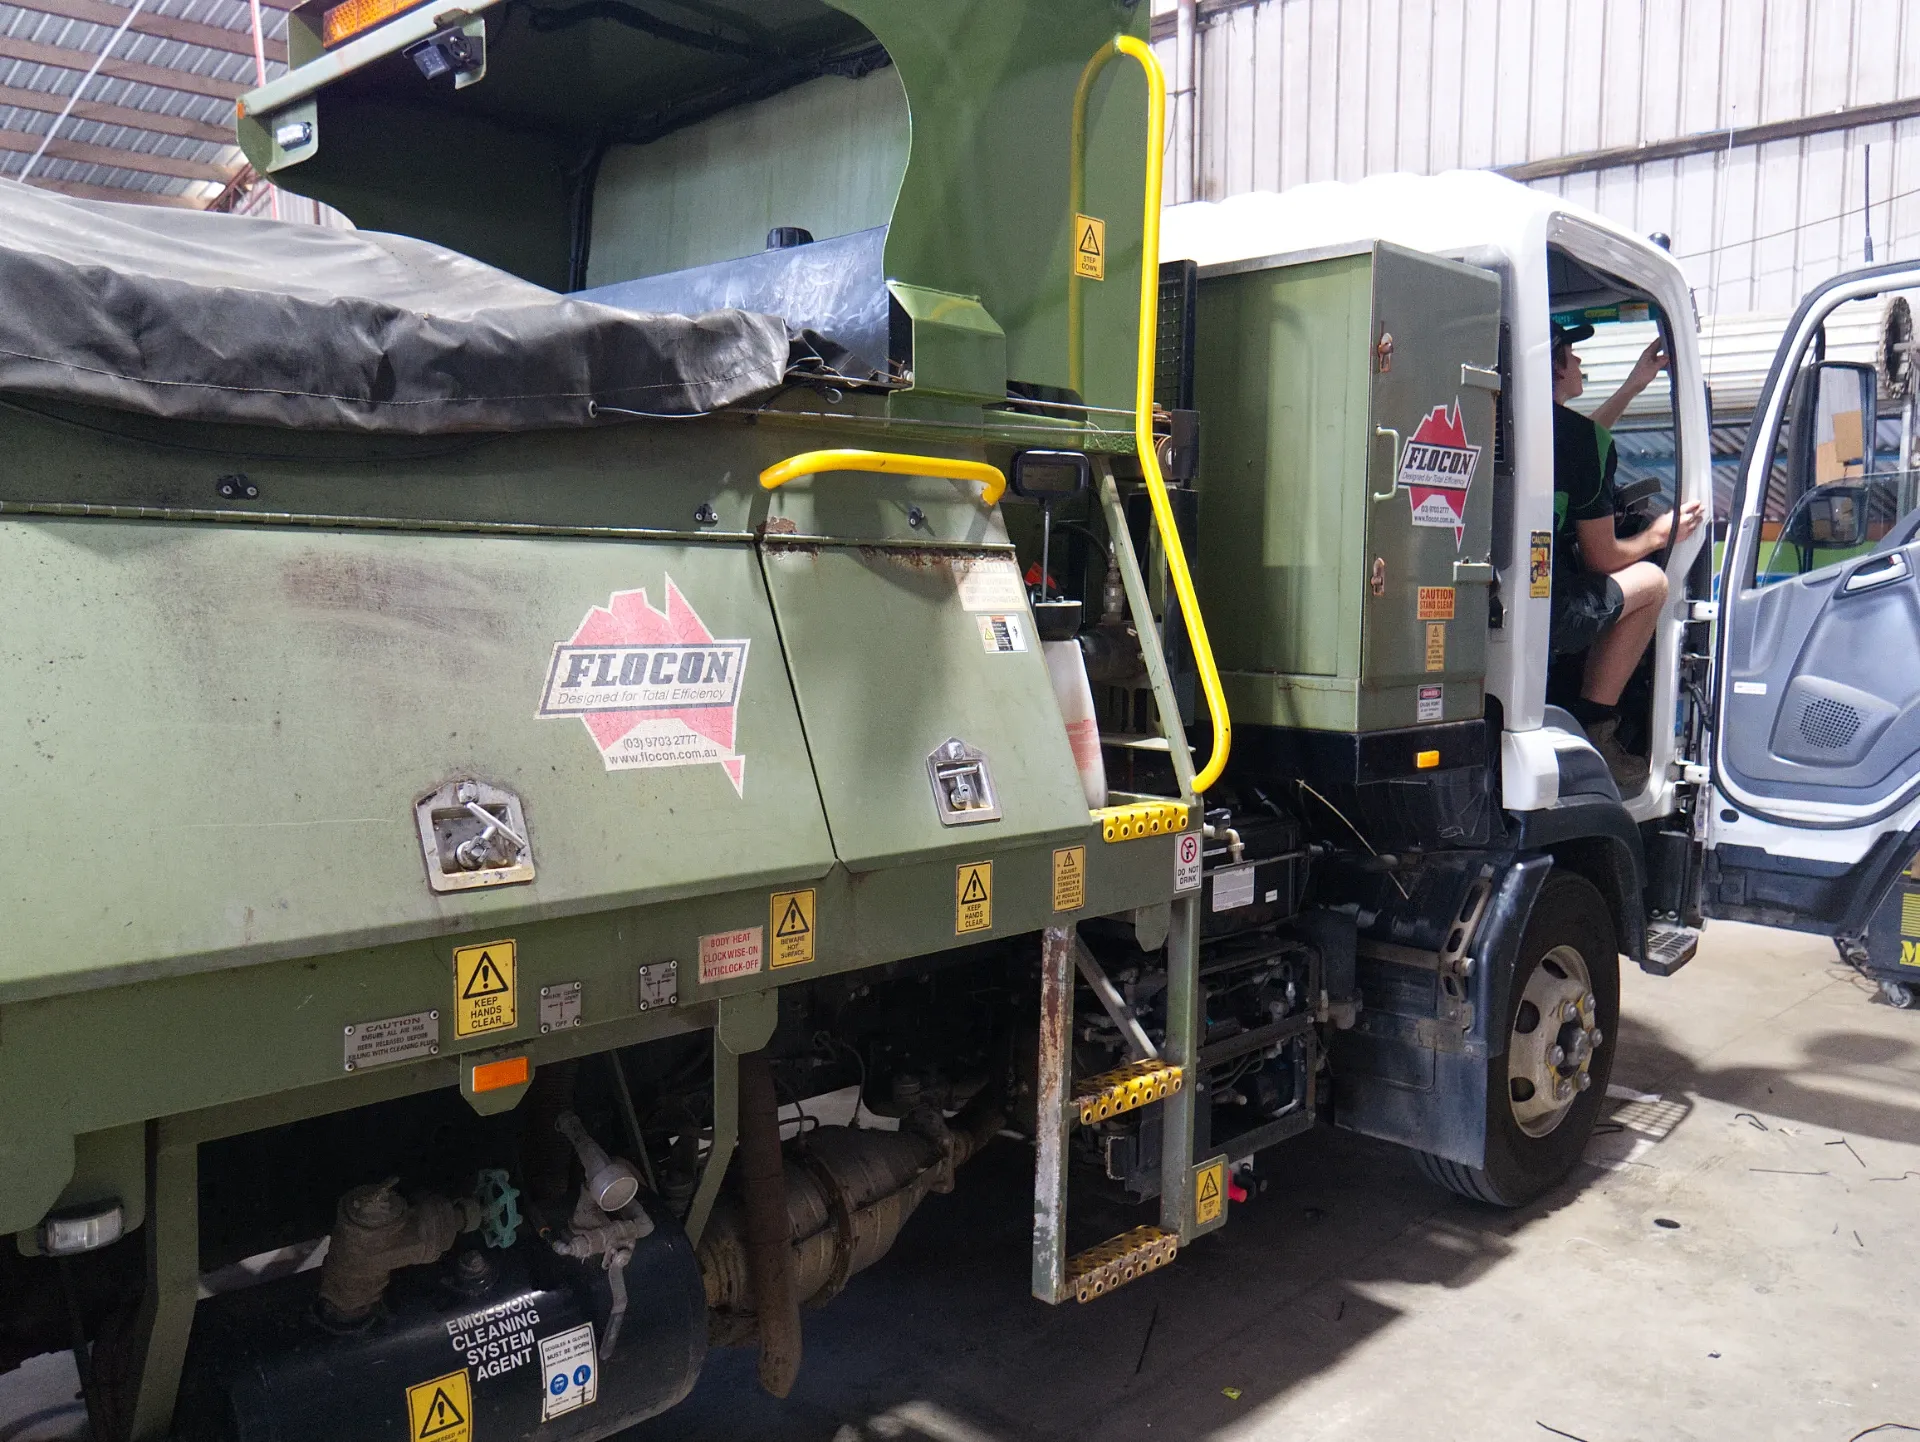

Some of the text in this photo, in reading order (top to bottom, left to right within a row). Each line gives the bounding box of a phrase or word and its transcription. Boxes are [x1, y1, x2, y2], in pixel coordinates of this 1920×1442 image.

[1082, 263, 1097, 272] DOWN
[1405, 448, 1474, 475] FLOCON
[1403, 472, 1425, 482] Designed
[1445, 477, 1465, 486] Efficiency
[1421, 589, 1453, 600] CAUTION
[1421, 601, 1453, 609] STAND CLEAR
[561, 652, 733, 688] FLOCON
[558, 688, 726, 705] Designed for Total Efficiency
[623, 738, 643, 750] (03)
[609, 749, 717, 764] www.flocon.com.au
[1058, 873, 1080, 881] CONVEYOR
[1178, 866, 1199, 877] DO NOT
[1180, 876, 1197, 885] DRINK
[968, 904, 981, 912] KEEP
[965, 920, 983, 928] CLEAR
[711, 933, 751, 948] BODY HEAT
[781, 937, 805, 945] BEWARE
[704, 947, 758, 964] CLOCKWISE-ON
[781, 950, 805, 959] SURFACE
[703, 960, 759, 978] ANTICLOCK-OFF
[475, 998, 498, 1008] KEEP
[471, 1006, 502, 1019] HANDS
[366, 1018, 421, 1033] CAUTION
[472, 1017, 502, 1029] CLEAR
[362, 1032, 384, 1041] ENSURE
[387, 1030, 397, 1038] ALL
[412, 1025, 424, 1033] HAS
[358, 1033, 428, 1051] BEEN RELEASED BEFORE
[372, 1048, 389, 1057] WITH
[391, 1042, 419, 1054] CLEANING
[447, 1298, 535, 1335] EMULSION
[453, 1310, 540, 1351] CLEANING
[467, 1329, 535, 1365] SYSTEM
[546, 1342, 566, 1353] GOGGLES
[572, 1333, 589, 1342] GLOVES
[547, 1352, 562, 1361] MUST
[574, 1342, 590, 1351] WORN
[477, 1349, 532, 1382] AGENT
